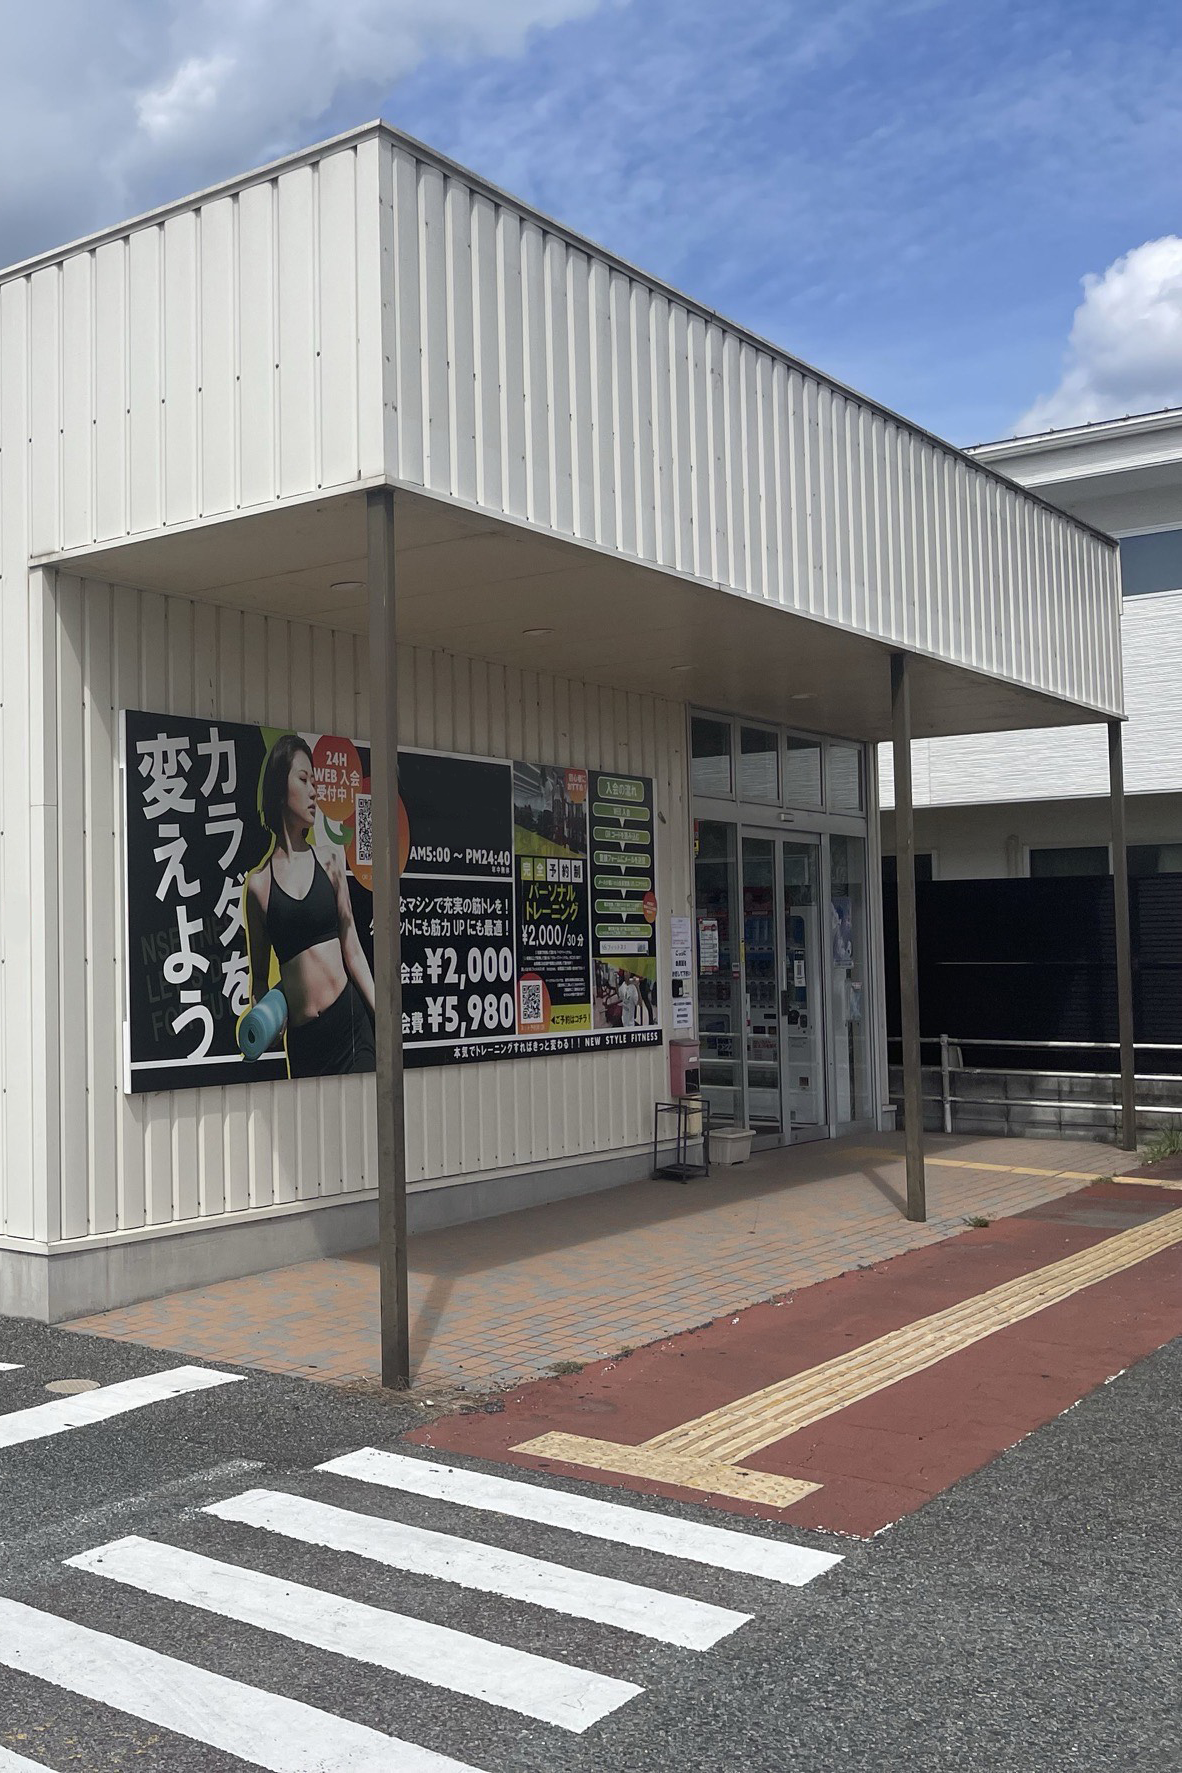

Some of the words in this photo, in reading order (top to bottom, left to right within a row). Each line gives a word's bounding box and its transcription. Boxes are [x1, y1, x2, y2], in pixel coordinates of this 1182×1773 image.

[326, 751, 347, 767] 24H
[314, 767, 337, 783] WEB
[340, 769, 360, 787] 入会
[317, 785, 354, 803] 受付中！
[606, 782, 637, 797] 入会の流れ
[409, 846, 451, 863] AM5:00
[465, 848, 511, 866] PM24:40
[197, 727, 252, 1017] カラダを
[522, 862, 581, 879] 完全予約制
[136, 733, 214, 1060] 変えよう
[529, 883, 575, 901] パーソナル
[526, 901, 578, 921] トレーニング
[424, 947, 513, 990] ¥2,000
[425, 993, 514, 1037] ¥5,980
[585, 1035, 601, 1047] NEW
[606, 1034, 627, 1045] STYLE
[631, 1031, 659, 1043] FITNESS
